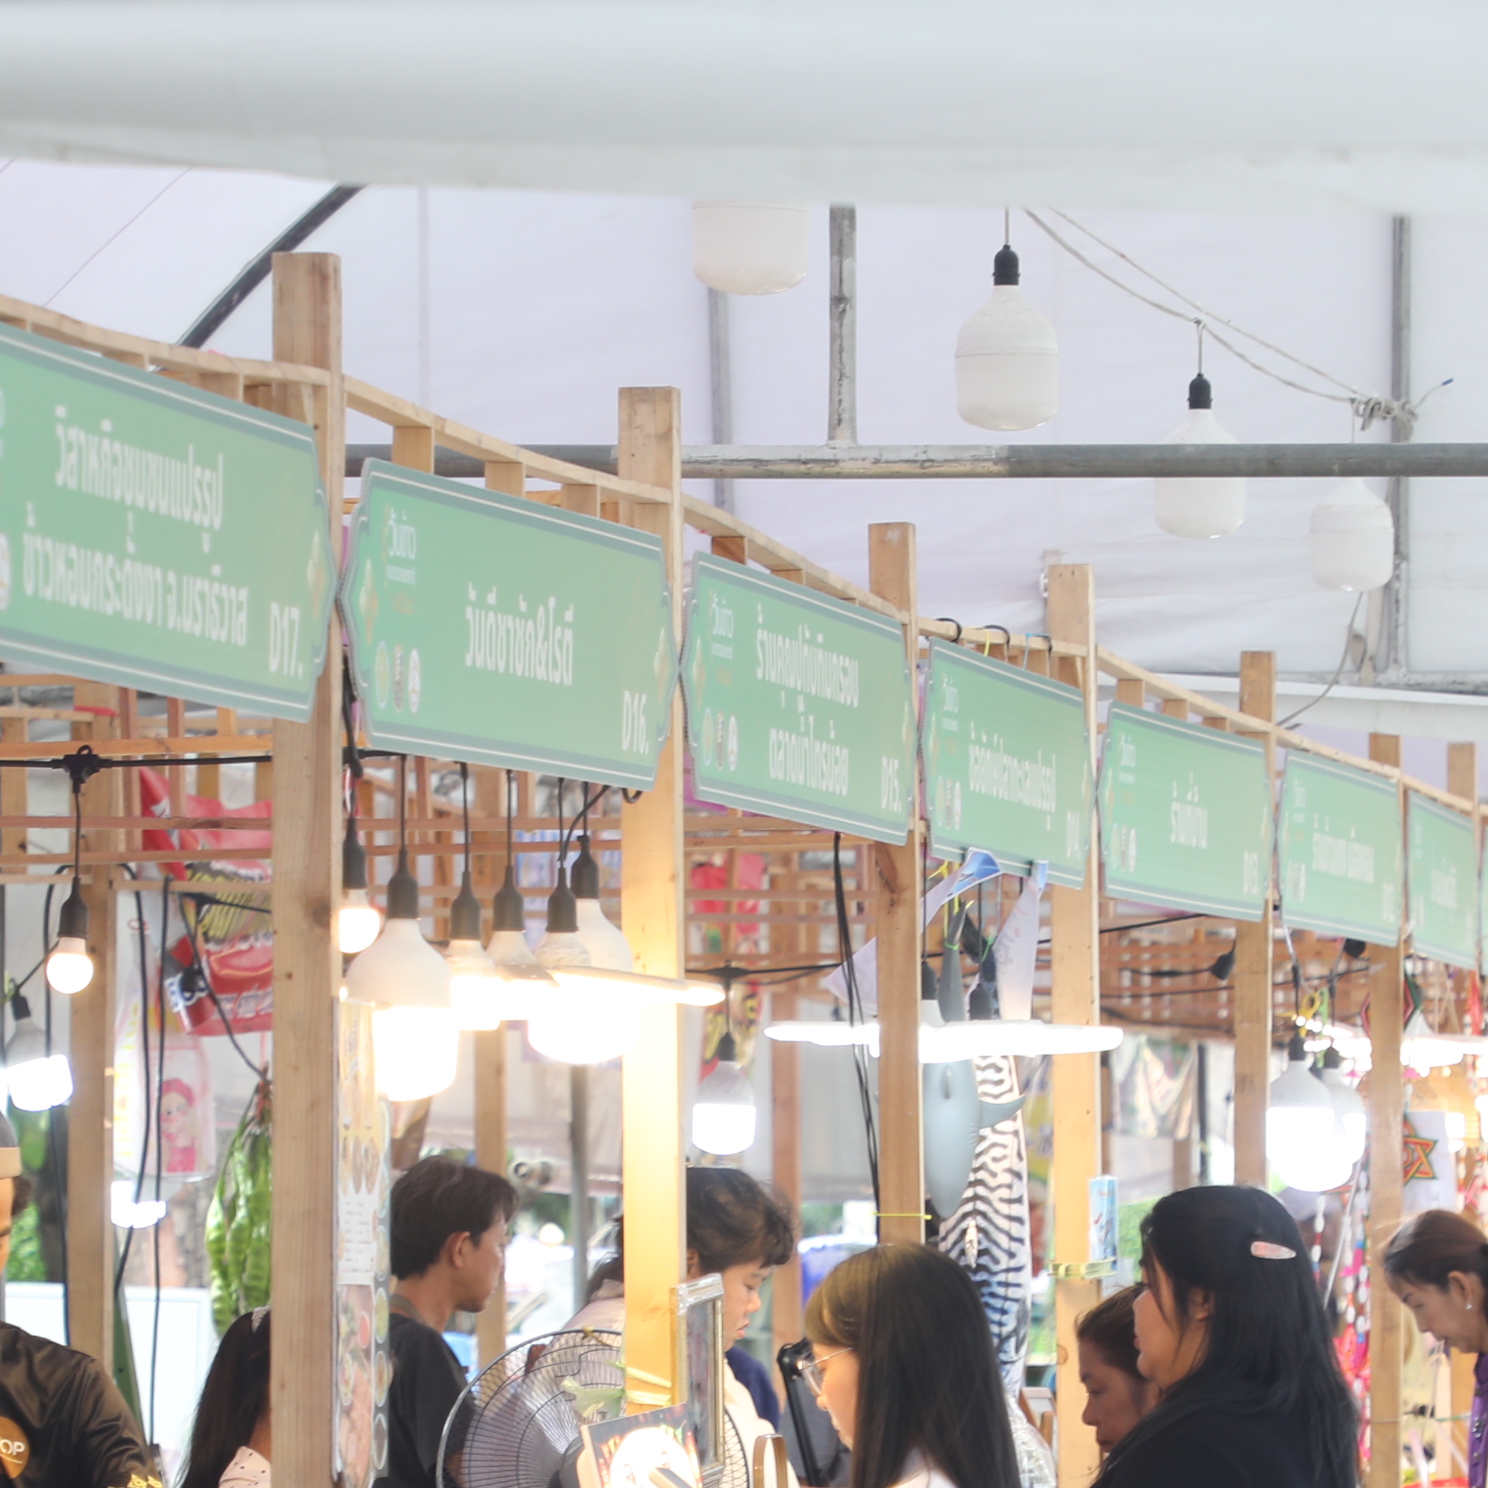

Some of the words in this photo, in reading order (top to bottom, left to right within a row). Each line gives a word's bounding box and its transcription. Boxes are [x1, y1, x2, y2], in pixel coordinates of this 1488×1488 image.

[268, 602, 304, 679] D17.
[465, 582, 574, 686] วันดีชาชัก&โรตี
